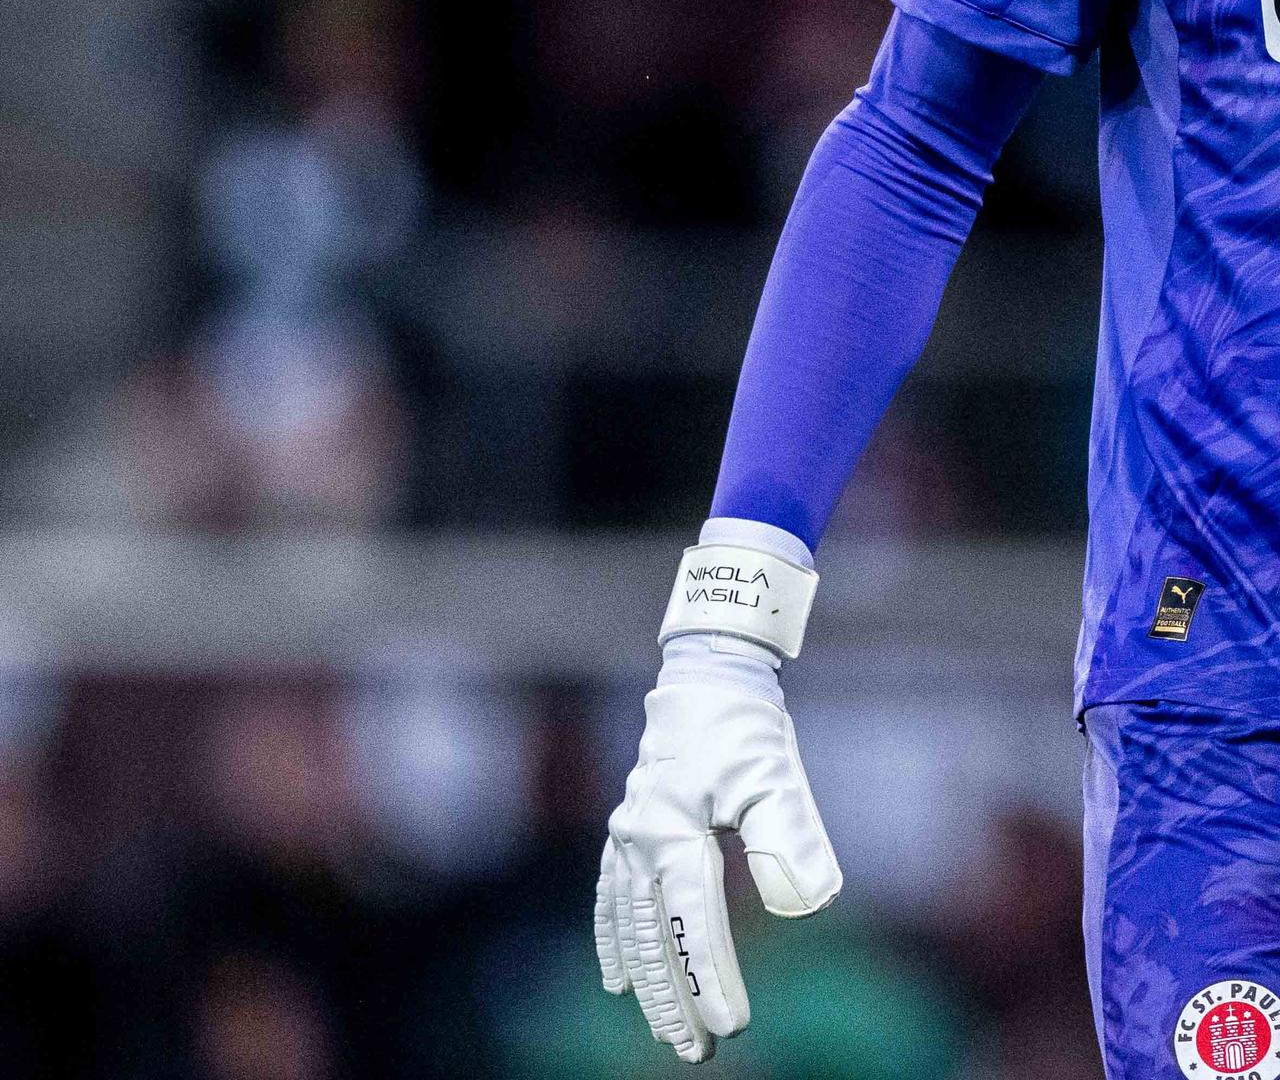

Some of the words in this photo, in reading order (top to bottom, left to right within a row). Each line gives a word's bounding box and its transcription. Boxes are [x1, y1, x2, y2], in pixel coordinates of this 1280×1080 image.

[686, 588, 760, 608] VASILJ
[1156, 619, 1187, 629] FOOTBALL
[1178, 1019, 1196, 1043] FC
[1192, 990, 1222, 1014] ST.
